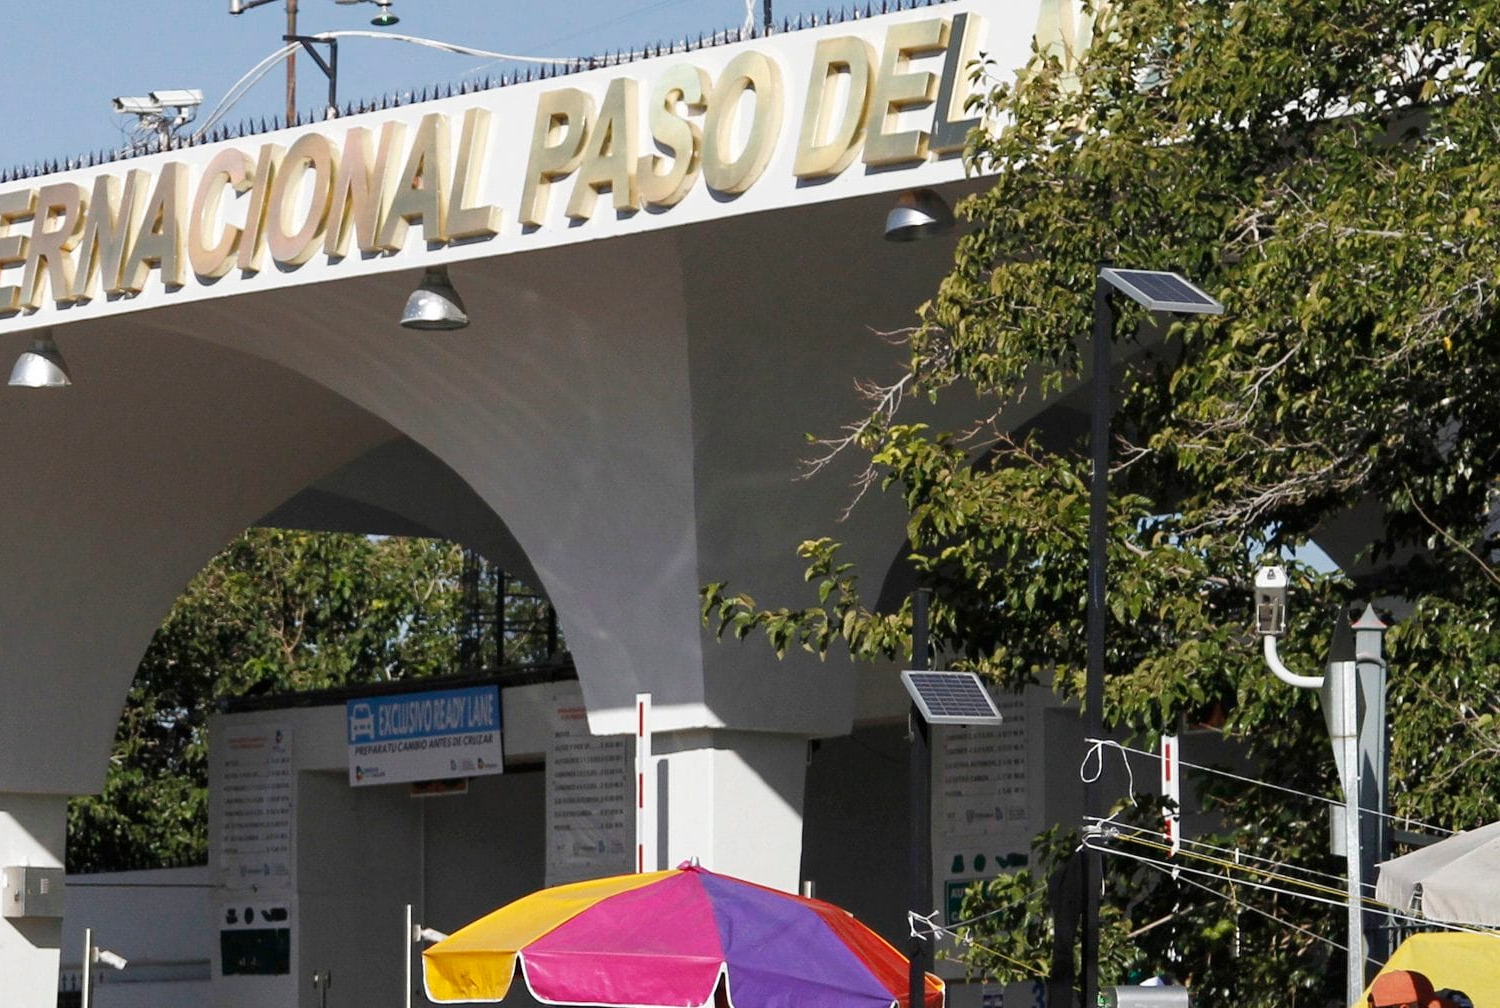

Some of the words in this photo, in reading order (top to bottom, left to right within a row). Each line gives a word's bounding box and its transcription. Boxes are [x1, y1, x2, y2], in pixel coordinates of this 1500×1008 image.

[518, 50, 782, 229] PASO
[793, 12, 990, 179] DEL
[379, 700, 432, 736] EXCLUSIVO
[435, 696, 466, 729] READY
[467, 693, 494, 726] LANE
[387, 742, 398, 753] TU
[398, 739, 428, 753] CAMBIO
[428, 737, 452, 749] ANTES
[452, 736, 462, 747] DE
[462, 733, 494, 745] CRUZAR
